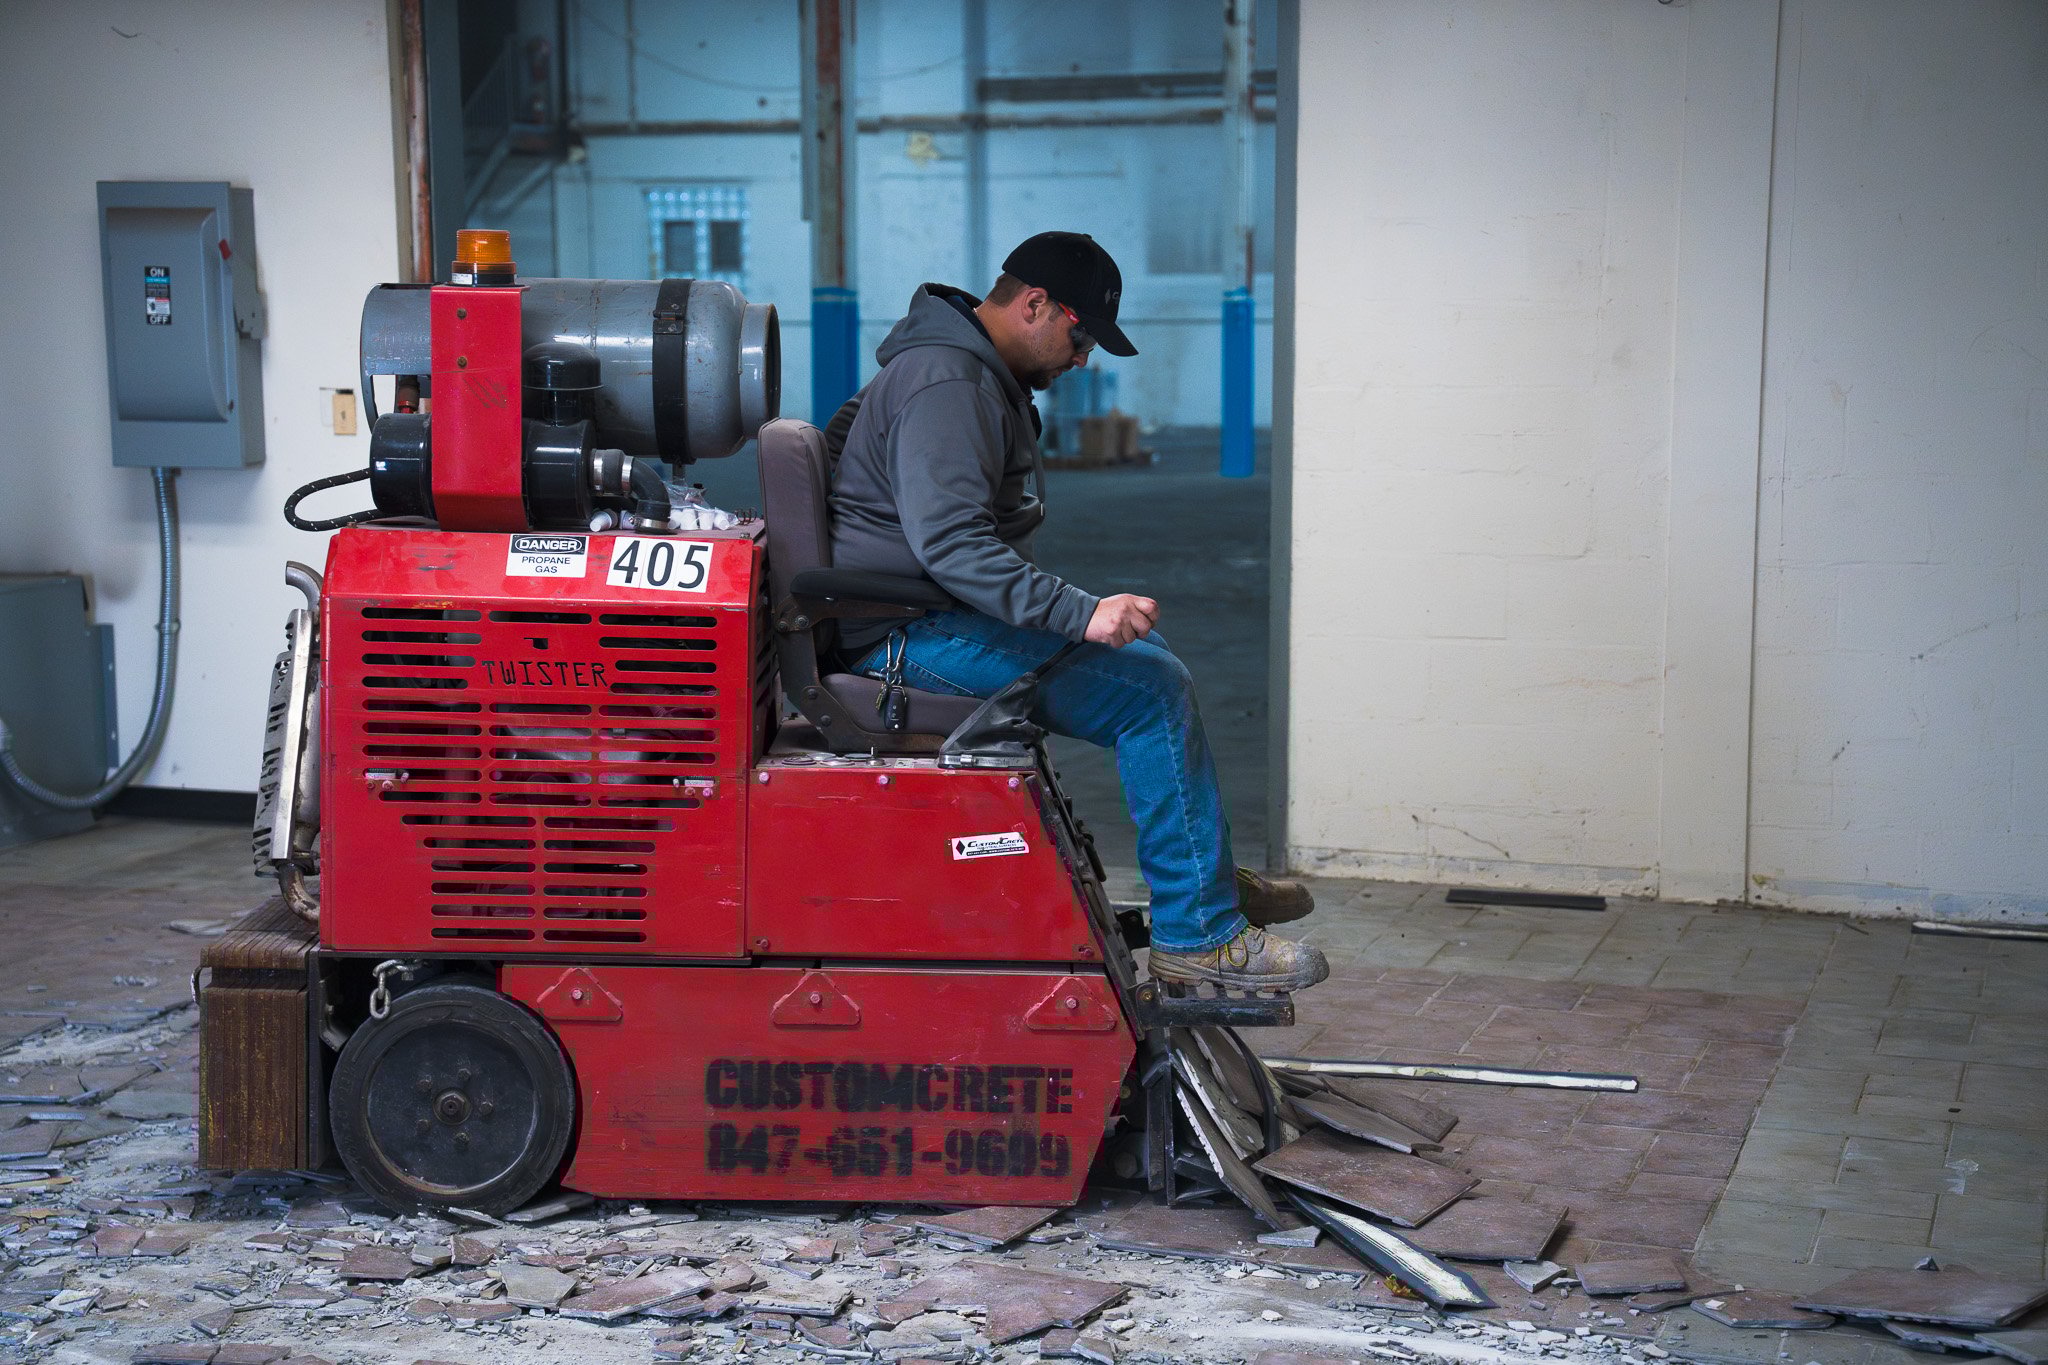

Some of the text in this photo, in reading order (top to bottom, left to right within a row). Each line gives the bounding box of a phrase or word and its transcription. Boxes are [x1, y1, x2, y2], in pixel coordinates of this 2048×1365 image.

[150, 267, 164, 277] ON
[150, 315, 168, 324] OFF
[520, 538, 577, 551] DANGER
[521, 555, 571, 565] PROPANE
[613, 539, 709, 589] 405
[535, 565, 558, 574] GAS
[481, 660, 608, 687] TWISTER
[705, 1058, 1074, 1115] CUSTOMCRETE
